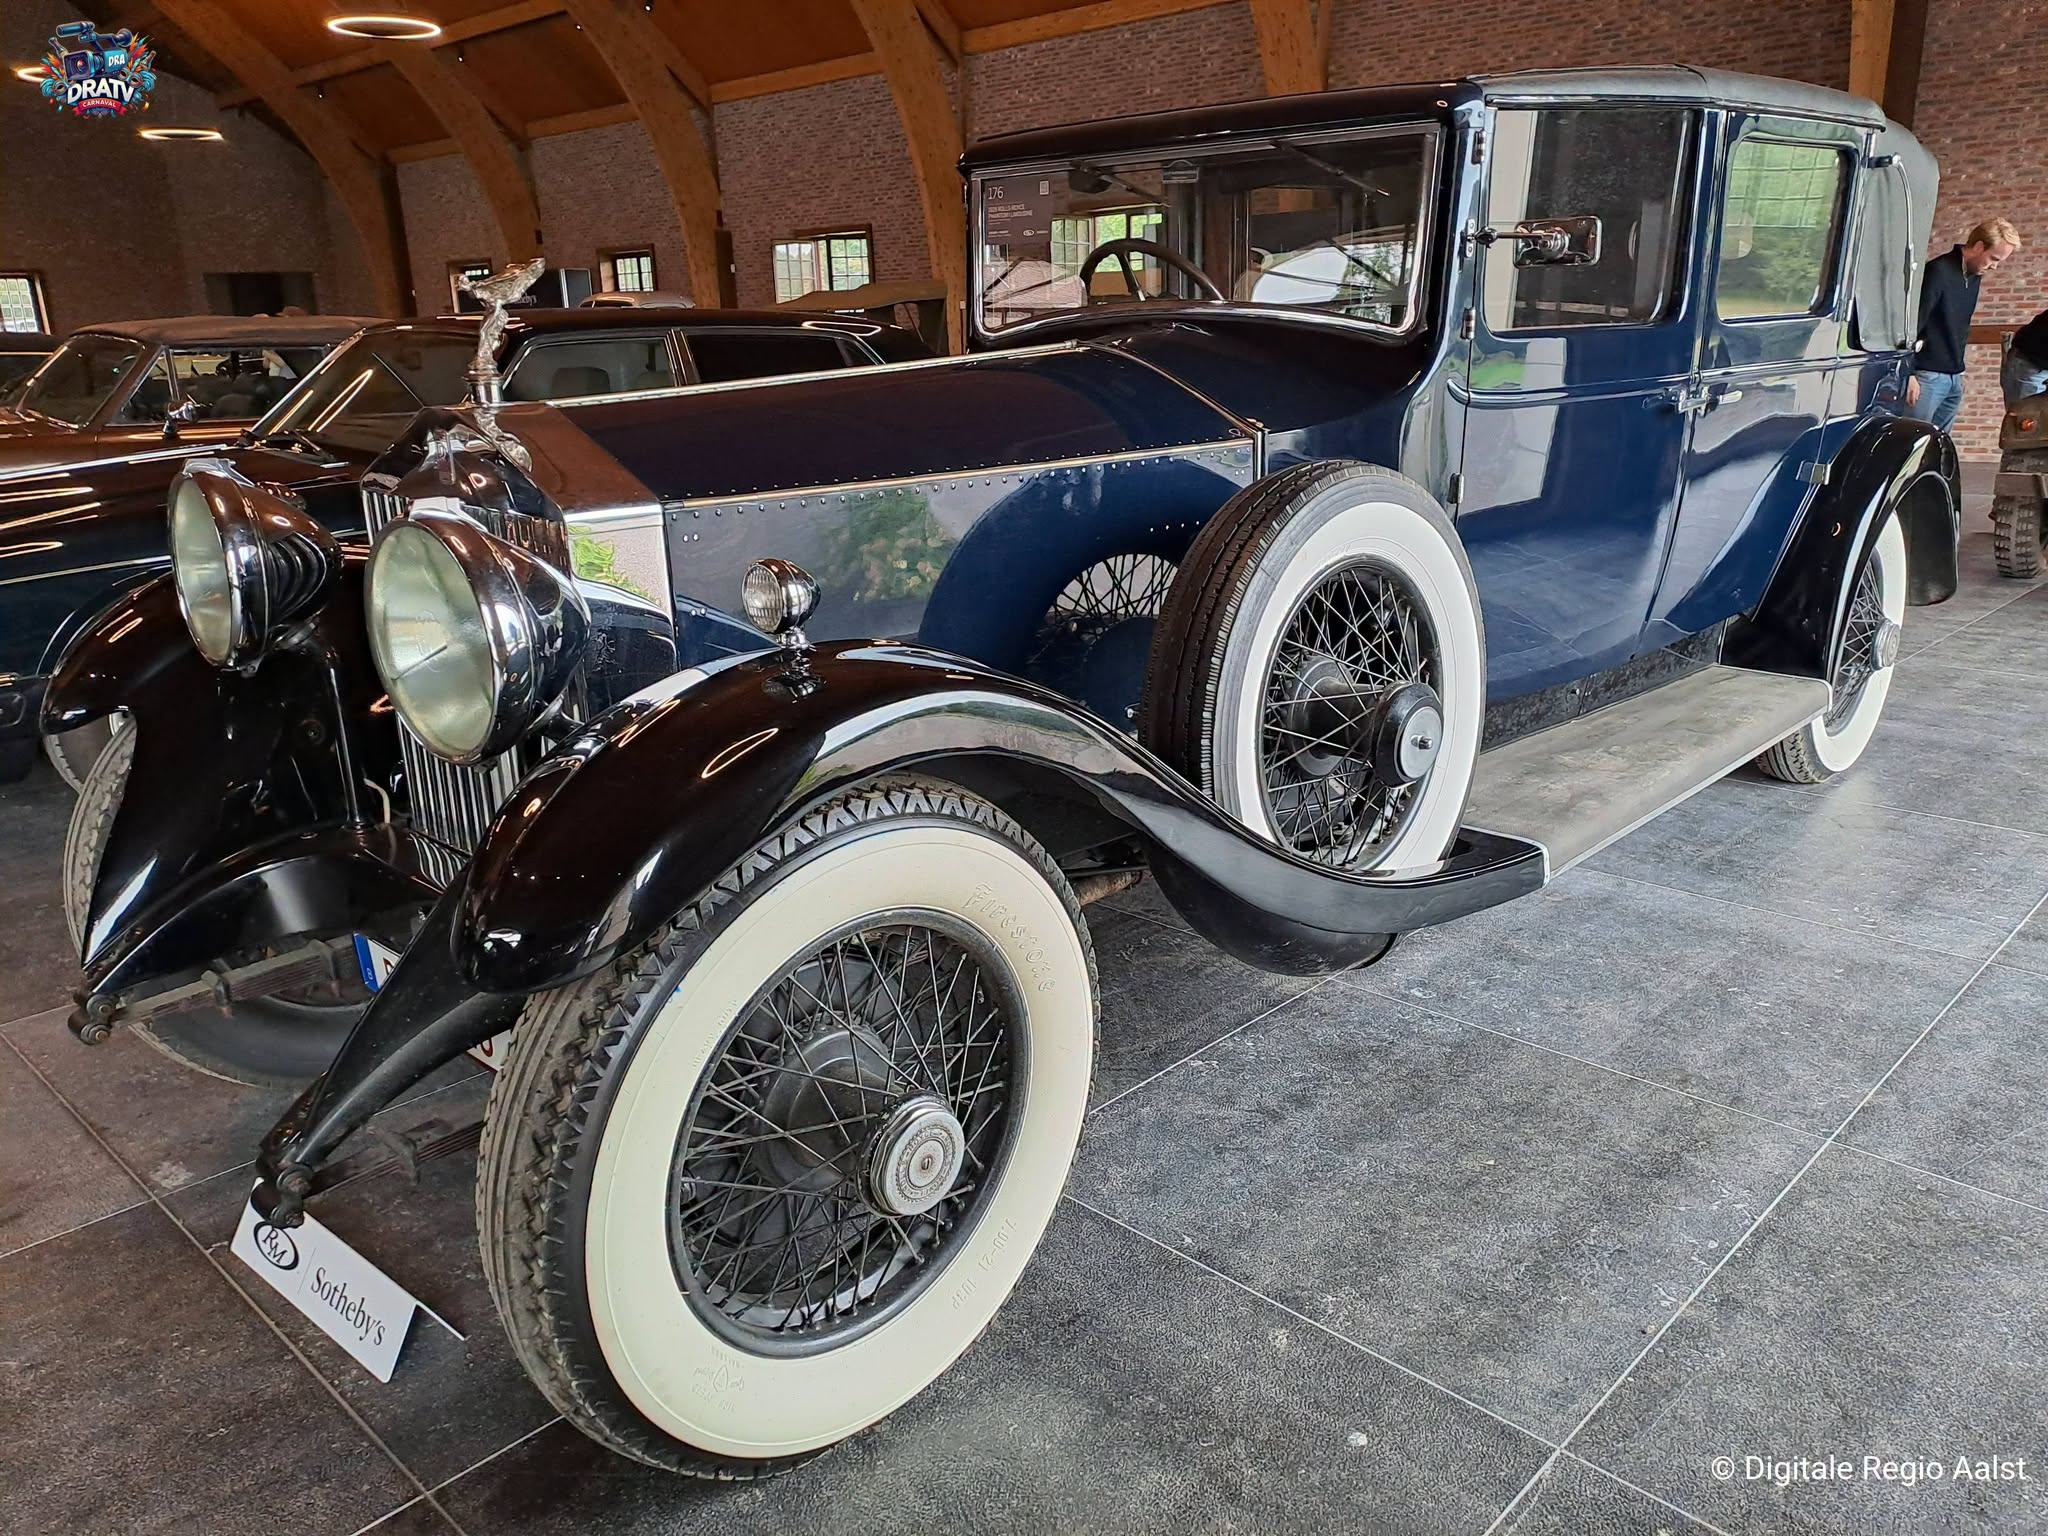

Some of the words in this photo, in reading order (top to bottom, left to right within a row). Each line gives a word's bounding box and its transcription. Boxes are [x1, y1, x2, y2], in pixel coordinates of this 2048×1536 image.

[988, 186, 1004, 200] 176
[262, 1227, 289, 1264] RM
[310, 1266, 386, 1346] Sotheby's
